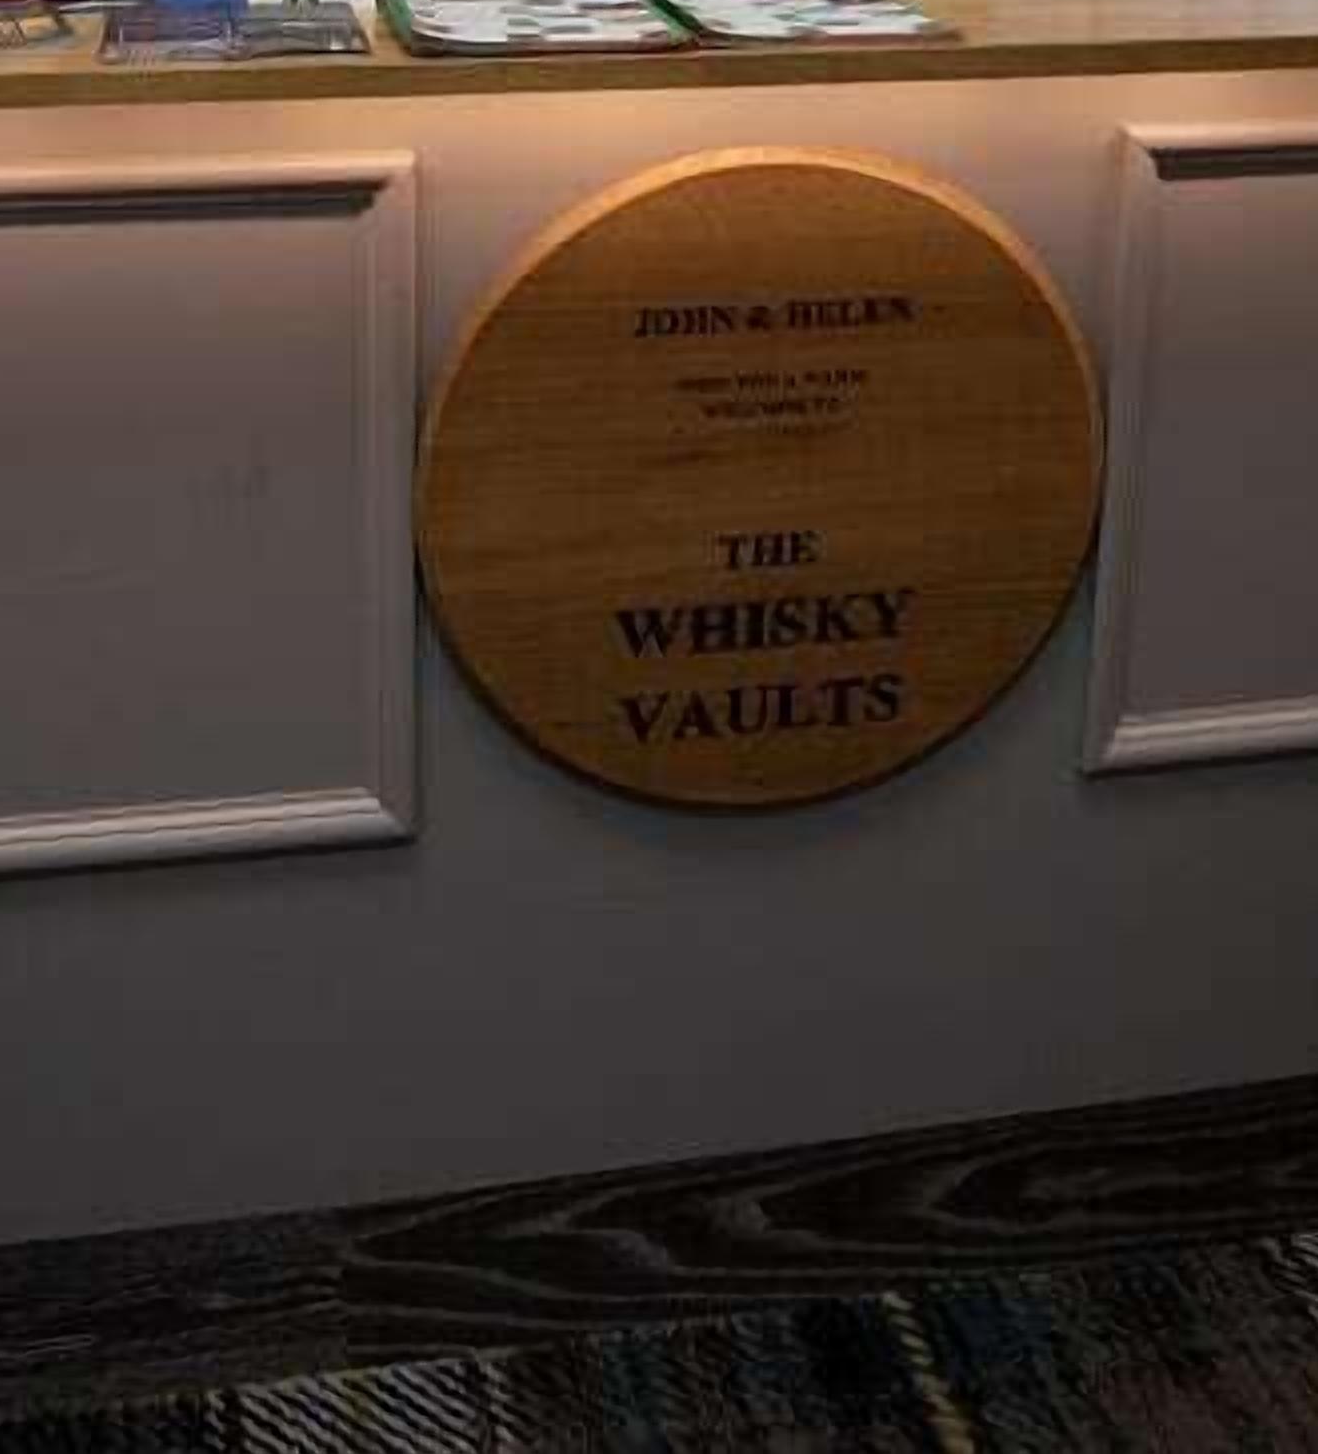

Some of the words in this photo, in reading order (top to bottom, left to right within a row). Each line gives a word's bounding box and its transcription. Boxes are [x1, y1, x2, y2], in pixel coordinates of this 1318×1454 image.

[634, 305, 736, 339] JOHN
[744, 304, 772, 331] &
[785, 296, 919, 330] HELEN
[718, 529, 821, 570] THE
[615, 587, 917, 659] WHISKY
[622, 673, 904, 745] VAULTS
